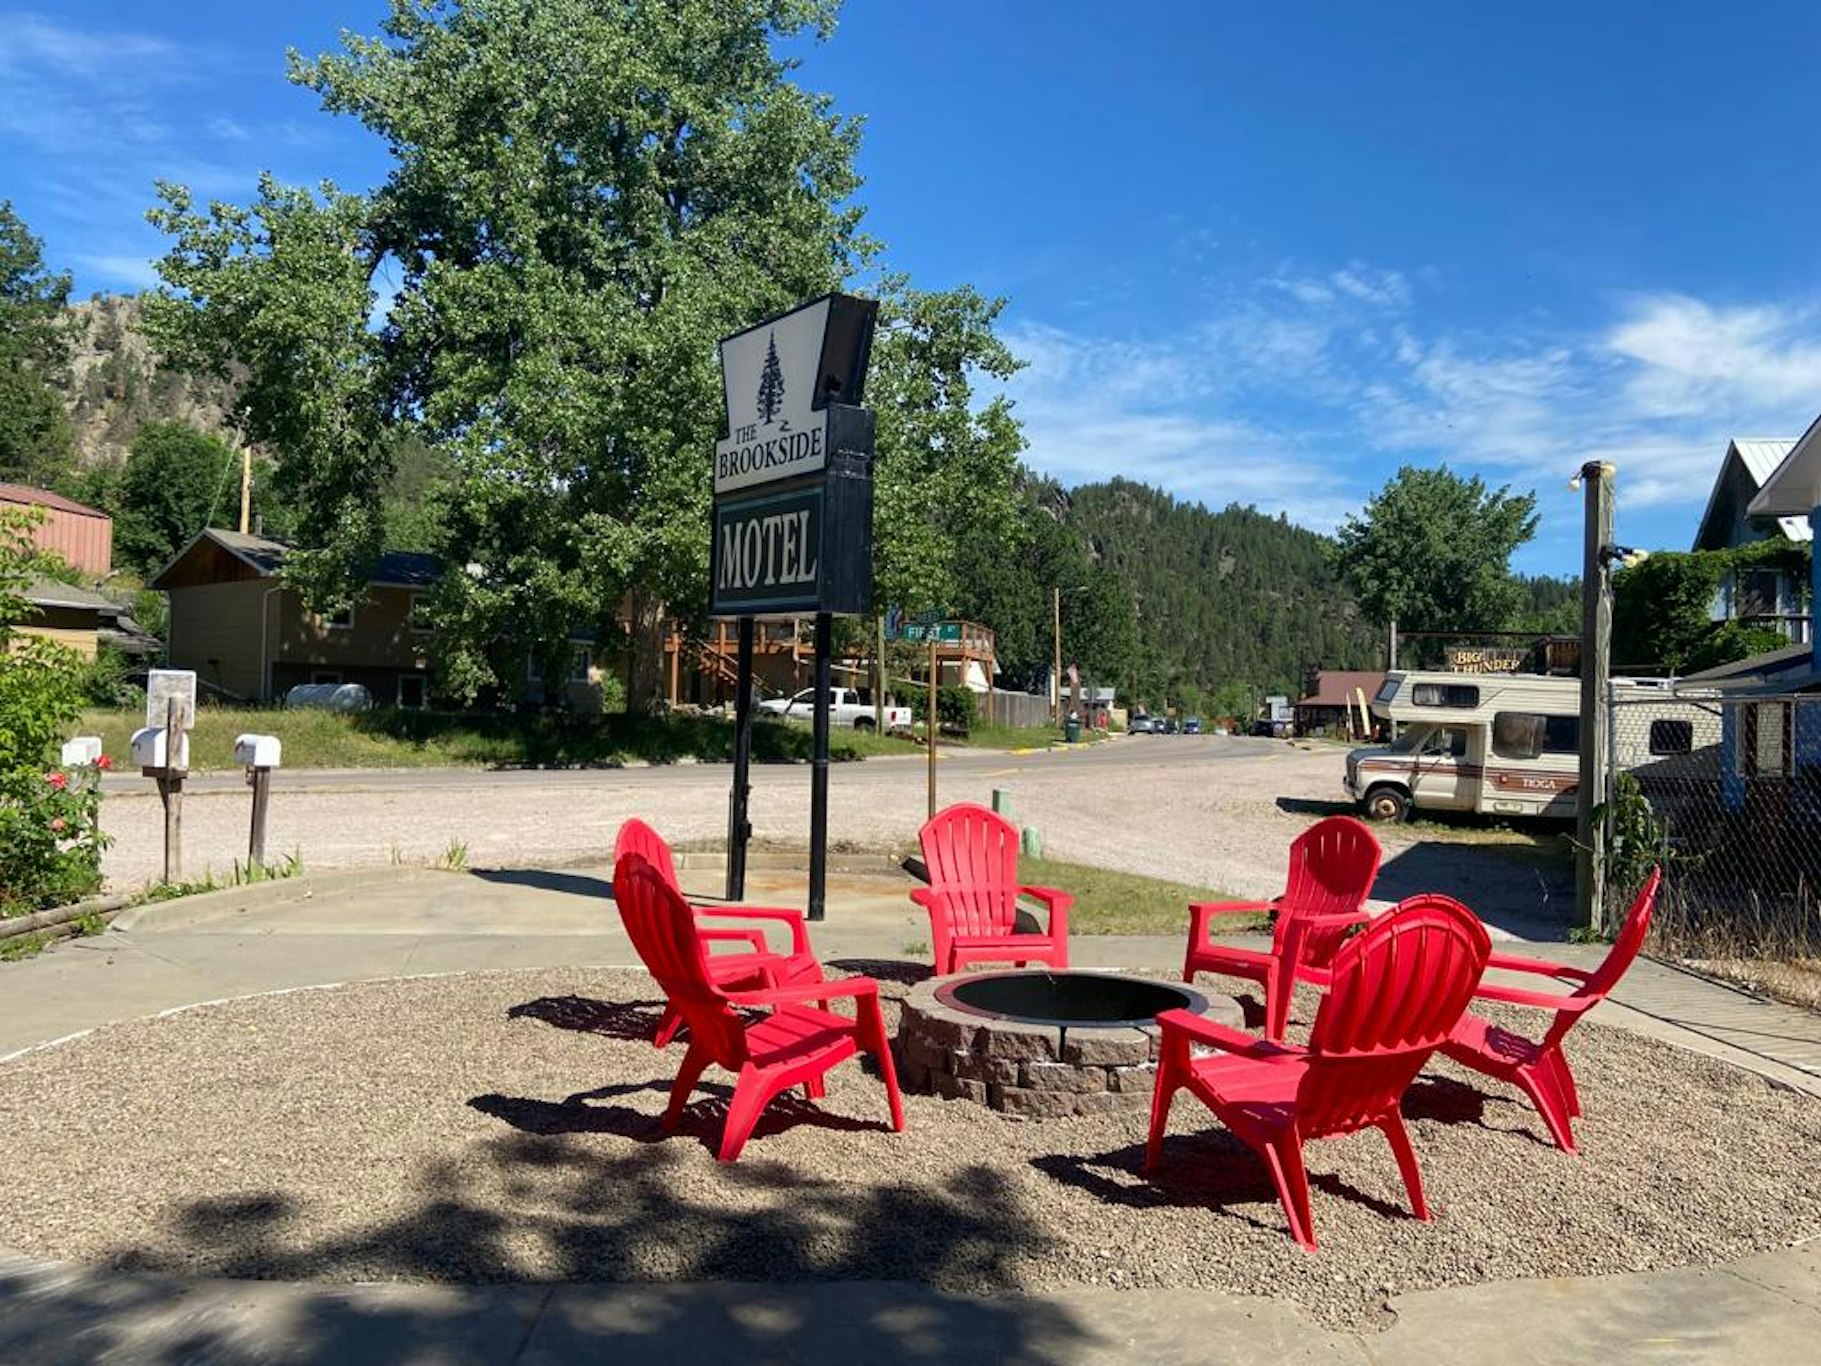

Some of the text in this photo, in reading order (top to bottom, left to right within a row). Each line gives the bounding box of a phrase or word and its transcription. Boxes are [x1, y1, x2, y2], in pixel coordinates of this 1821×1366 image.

[735, 424, 757, 445] THE
[718, 428, 822, 479] BROOKSIDE
[719, 510, 818, 589] MOTEL
[1456, 651, 1482, 665] BIG
